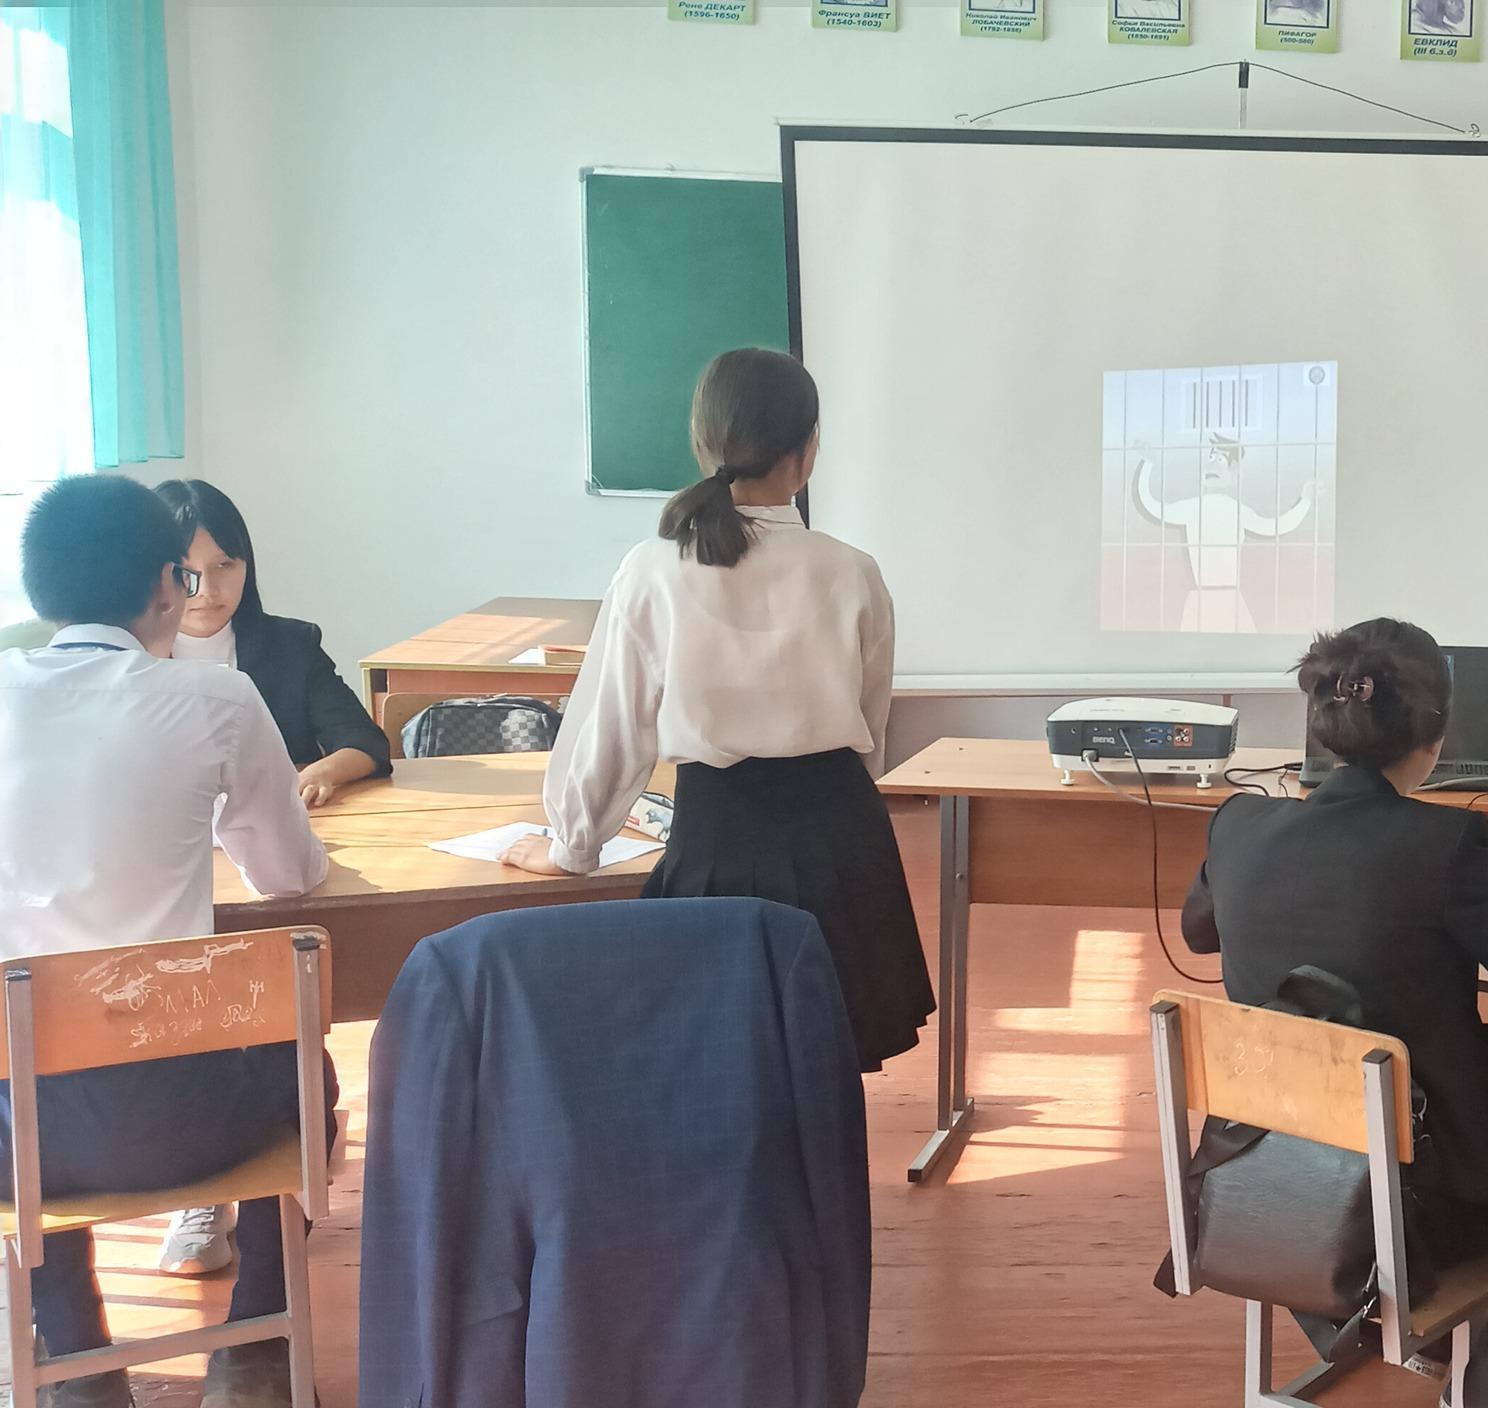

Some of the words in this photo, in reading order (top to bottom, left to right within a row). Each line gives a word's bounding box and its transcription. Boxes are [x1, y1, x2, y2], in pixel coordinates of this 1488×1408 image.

[704, 3, 747, 11] ДЕКАРТ
[684, 10, 740, 20] (1596-1650)
[818, 10, 861, 18] Франсуа
[827, 18, 882, 28] (1540-1603)
[971, 19, 1031, 27] ЛОБАЧЕВСКИЙ
[1119, 26, 1178, 34] КОВАЛЕВСКАЯ
[1413, 38, 1458, 48] ЕВКЛИД
